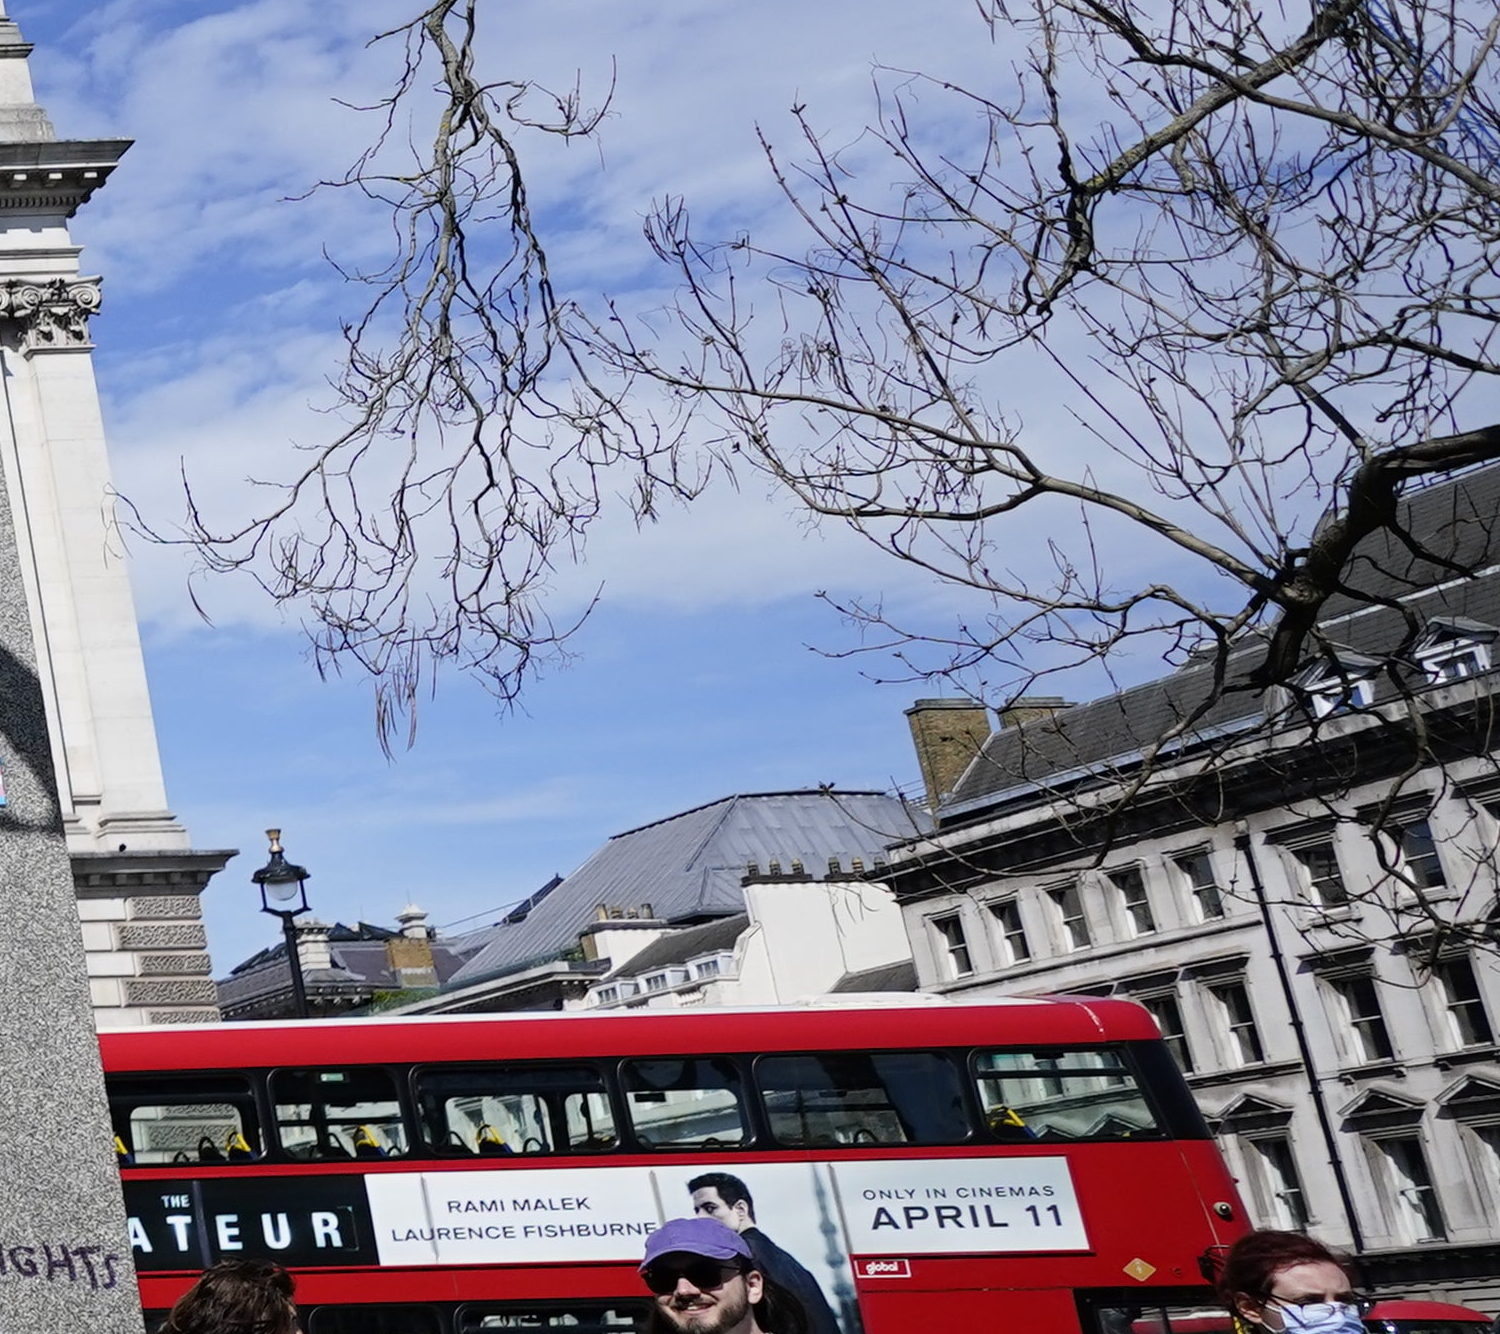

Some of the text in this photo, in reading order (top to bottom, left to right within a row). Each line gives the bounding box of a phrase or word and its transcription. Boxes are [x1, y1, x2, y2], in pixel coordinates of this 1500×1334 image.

[161, 1194, 190, 1208] THE
[862, 1185, 1055, 1201] ONLY IN CINEMAS
[447, 1197, 591, 1213] RAMI MALEK
[871, 1204, 1063, 1230] APRIL 11
[392, 1222, 657, 1242] LAURENCE FISHBURNE
[866, 1261, 898, 1275] global
